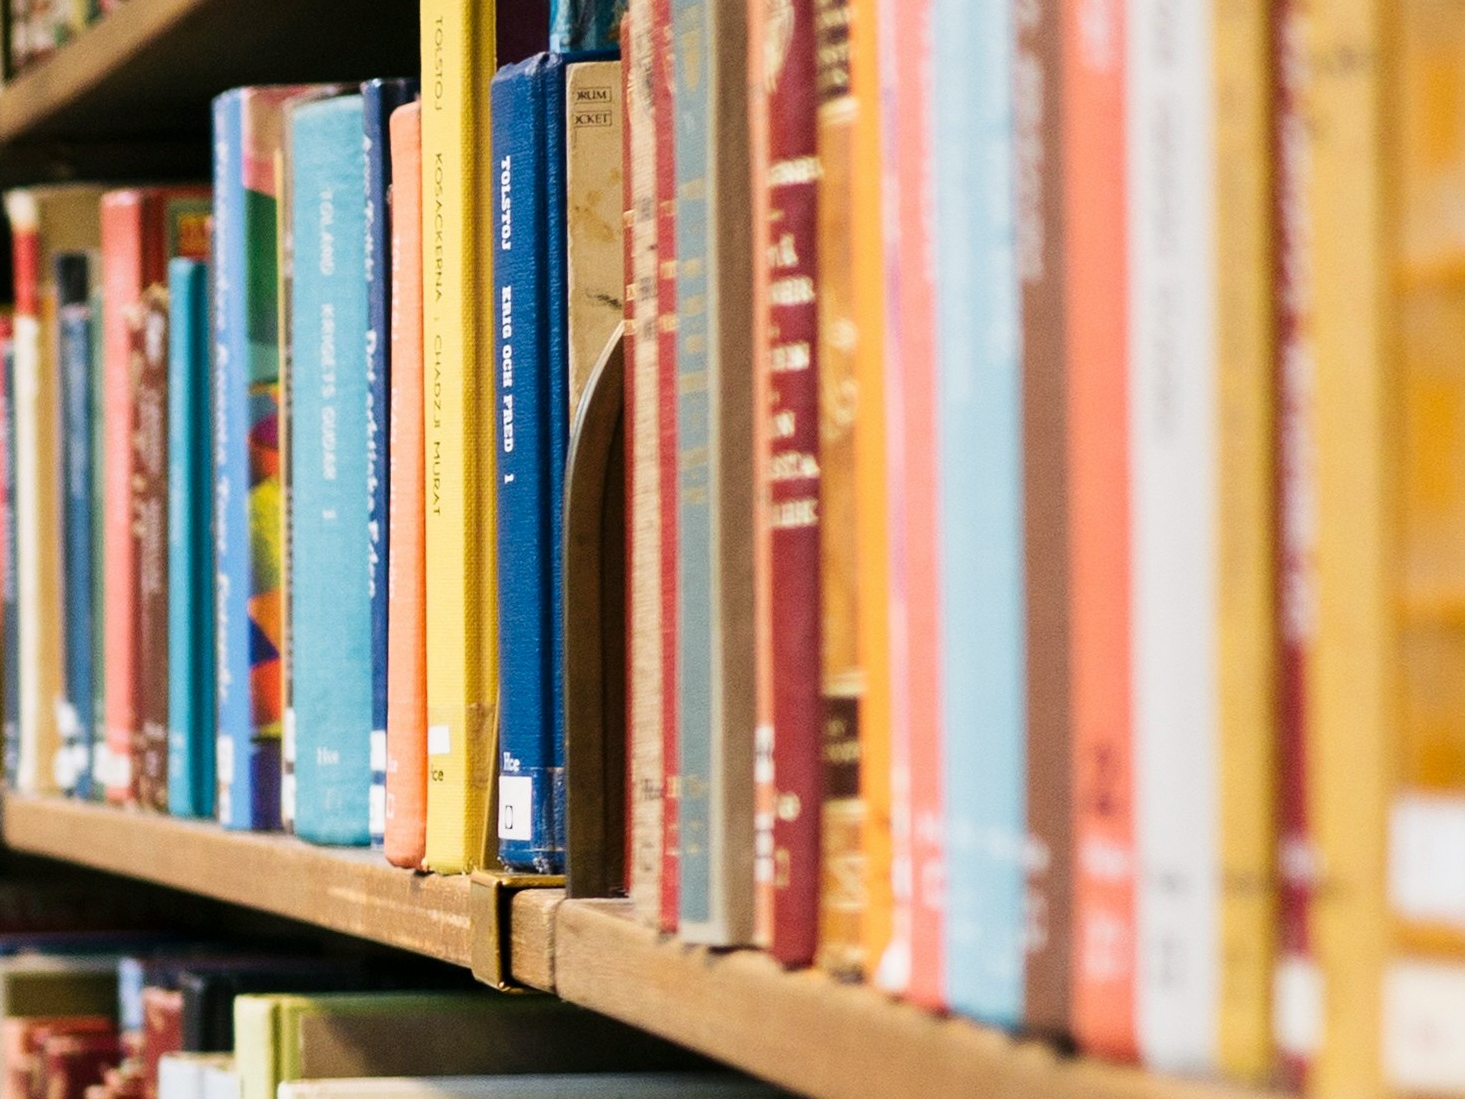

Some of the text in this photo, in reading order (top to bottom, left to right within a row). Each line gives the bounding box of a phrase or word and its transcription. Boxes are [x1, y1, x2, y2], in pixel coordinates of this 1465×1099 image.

[434, 15, 444, 112] TOLSTOJ
[319, 188, 335, 277] TOLAND
[433, 152, 444, 304] KOSACKERNA
[500, 155, 512, 250] TOLSTOJ
[321, 302, 336, 398] KRIGETS
[501, 285, 512, 339] KRIG
[502, 344, 513, 389] OCH
[322, 404, 337, 479] GUDAR
[502, 394, 514, 453] FRED
[432, 440, 442, 517] MURAT
